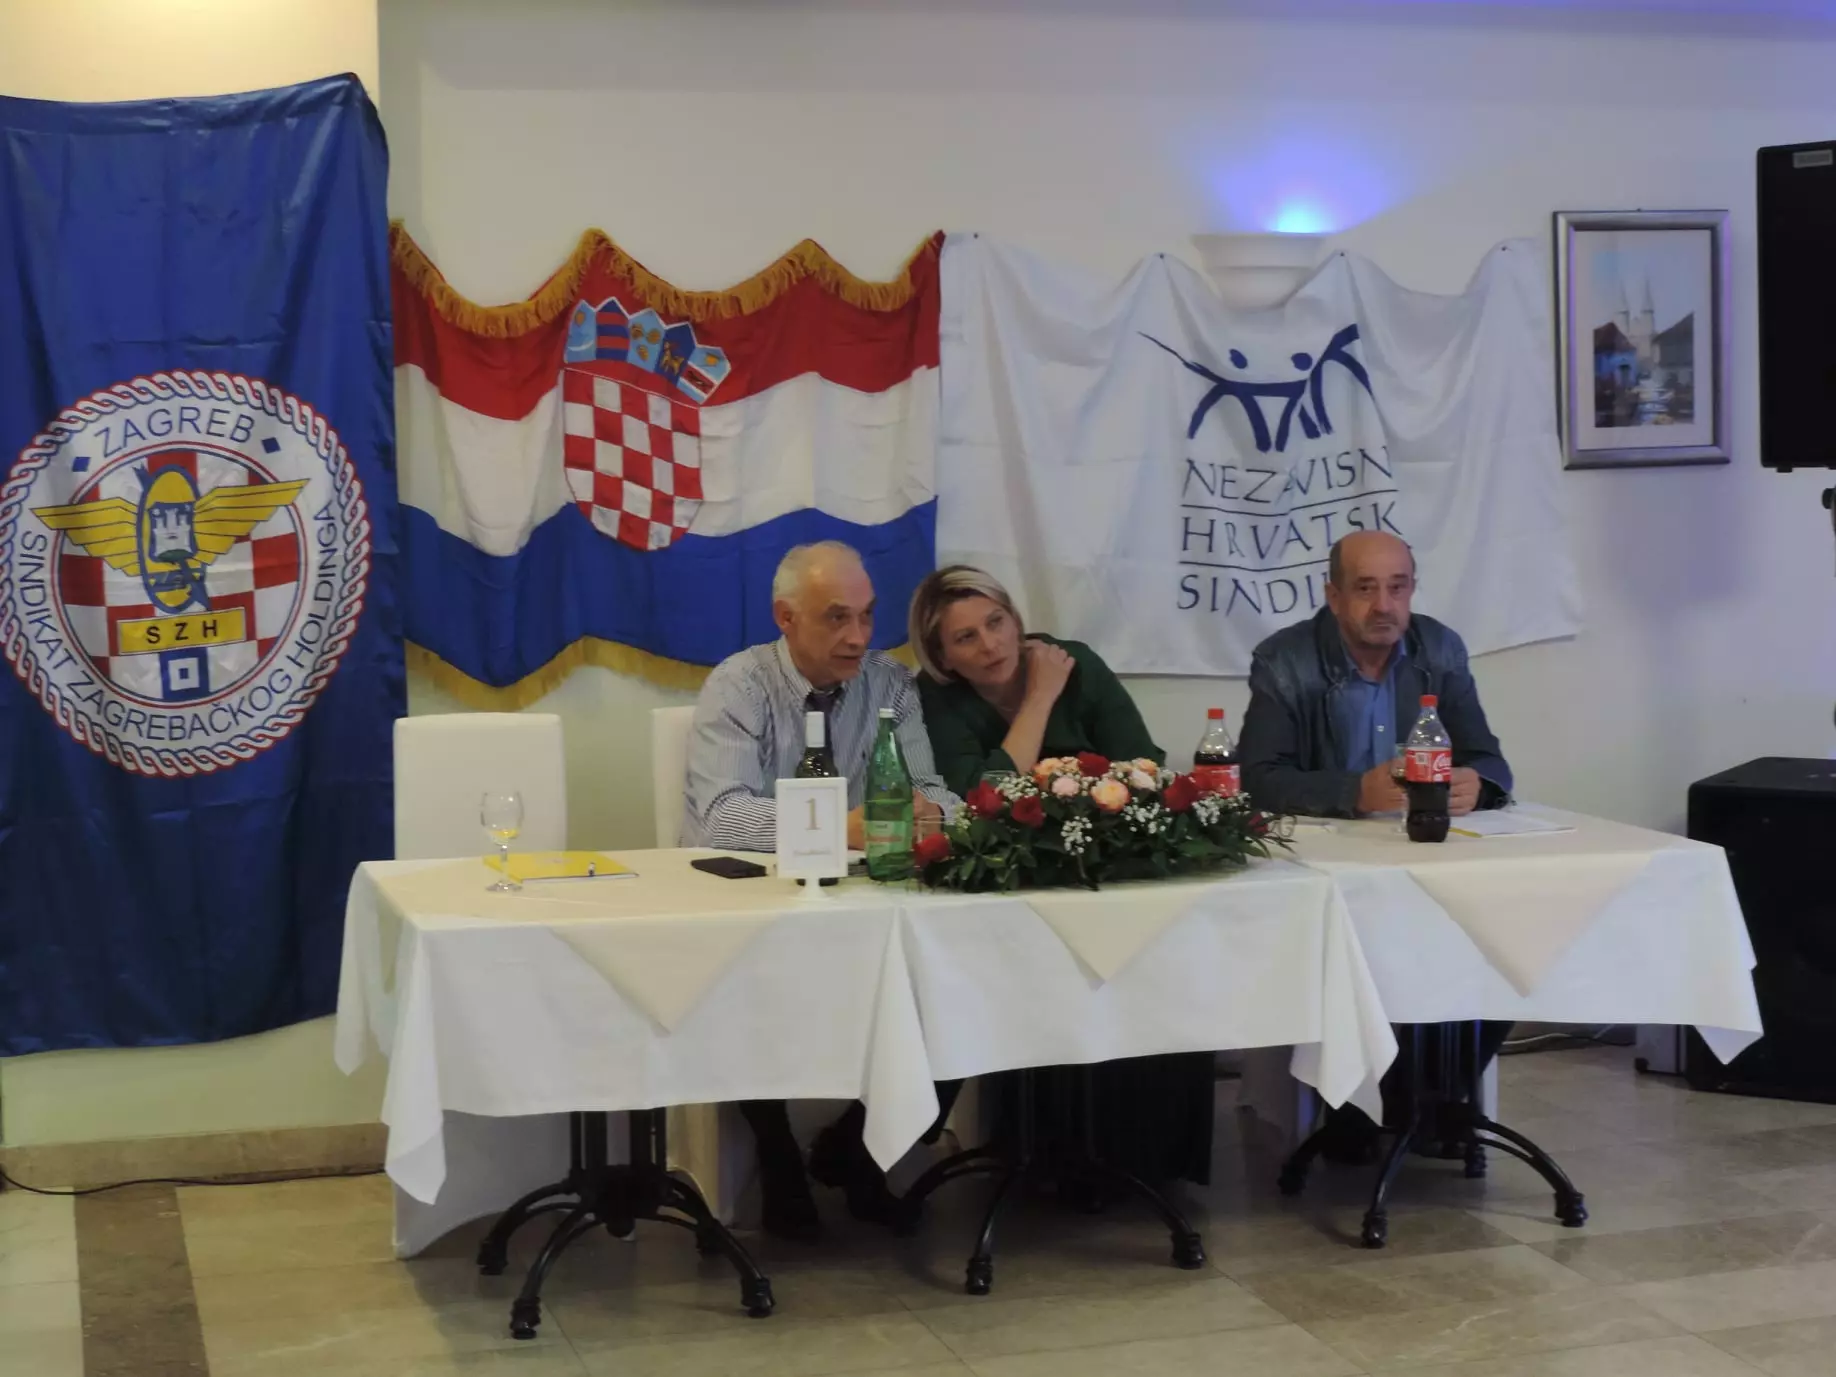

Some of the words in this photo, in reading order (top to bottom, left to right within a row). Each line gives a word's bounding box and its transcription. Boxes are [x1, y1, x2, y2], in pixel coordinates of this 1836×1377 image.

[94, 406, 255, 458] ZAGREB
[1176, 572, 1329, 617] SINDI
[19, 530, 79, 670] SINDIKAT
[67, 668, 293, 741] ZAGREBAČKOG
[286, 501, 338, 668] HOLDINGA
[805, 798, 821, 831] 1
